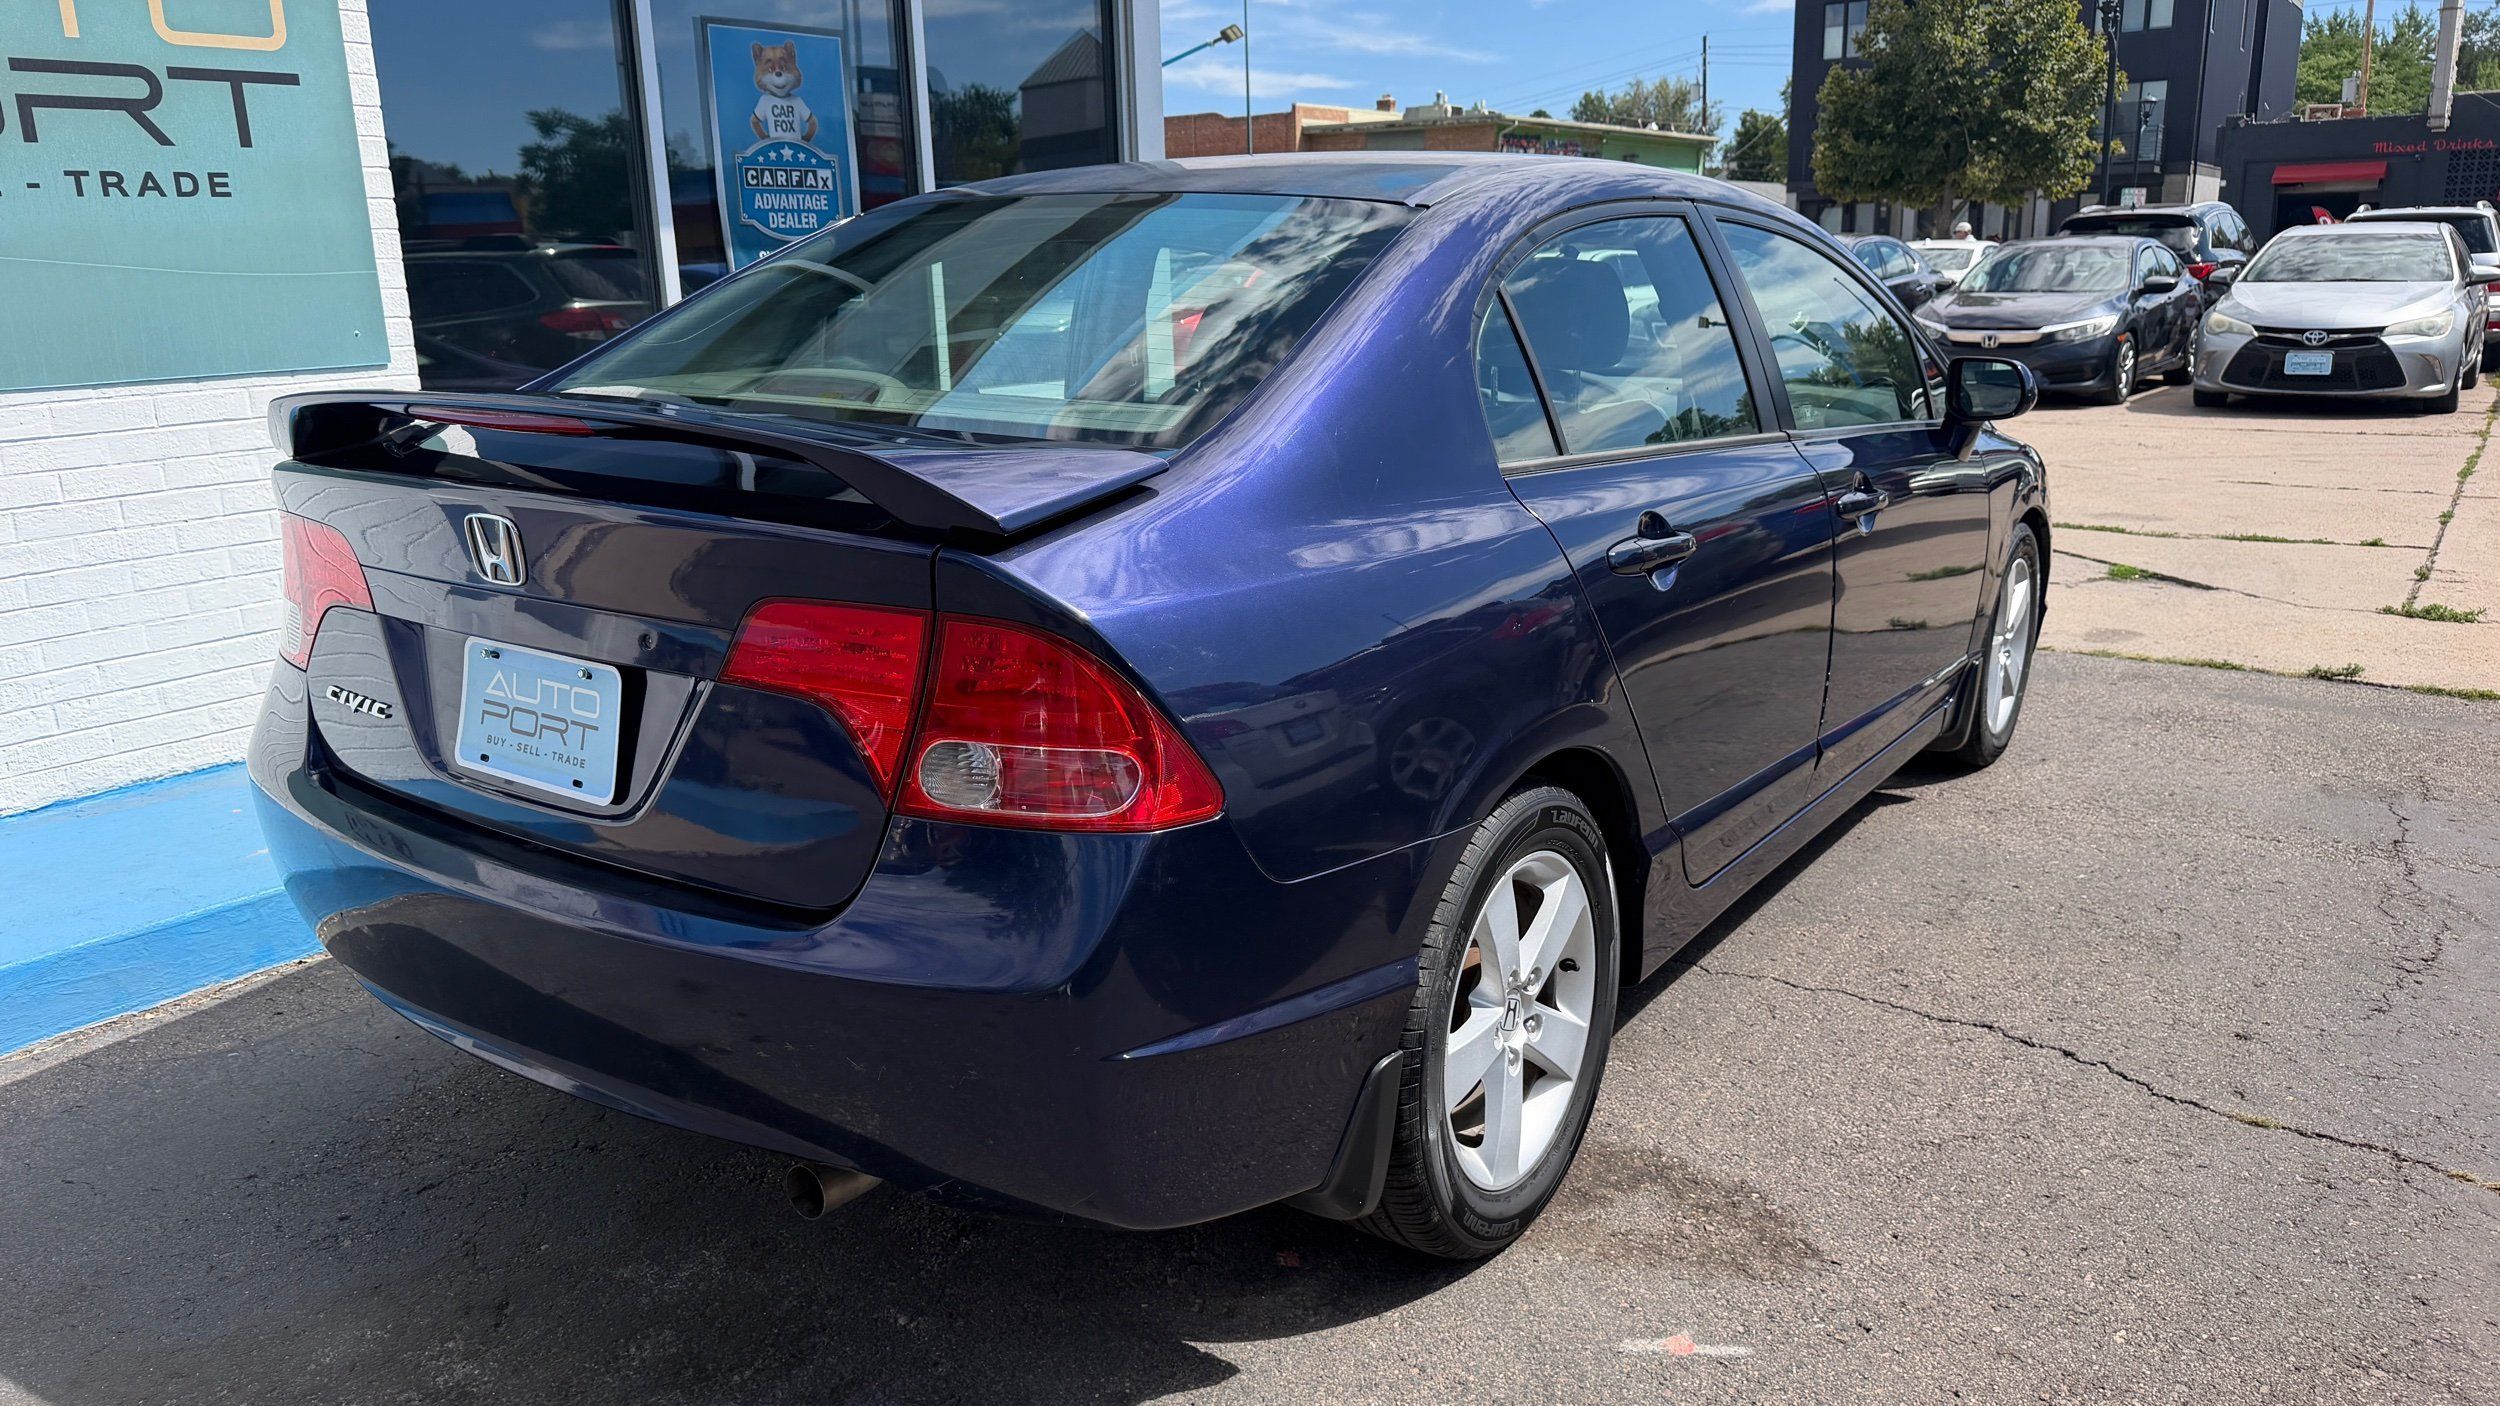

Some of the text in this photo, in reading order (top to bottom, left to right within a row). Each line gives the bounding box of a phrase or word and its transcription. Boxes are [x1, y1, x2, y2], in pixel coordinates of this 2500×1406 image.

[771, 104, 795, 118] CAR
[774, 120, 796, 133] FOX
[2433, 139, 2497, 151] Drinks
[63, 170, 233, 198] TRADE
[746, 169, 830, 189] CARFAX
[754, 193, 829, 210] ADVANTAGE
[768, 212, 818, 229] DEALER
[325, 685, 389, 719] CIVIC
[485, 669, 600, 719] AUTO
[480, 698, 599, 751] PORT
[486, 734, 506, 747] BUY
[516, 742, 540, 757] SELL
[552, 751, 586, 769] TRADE
